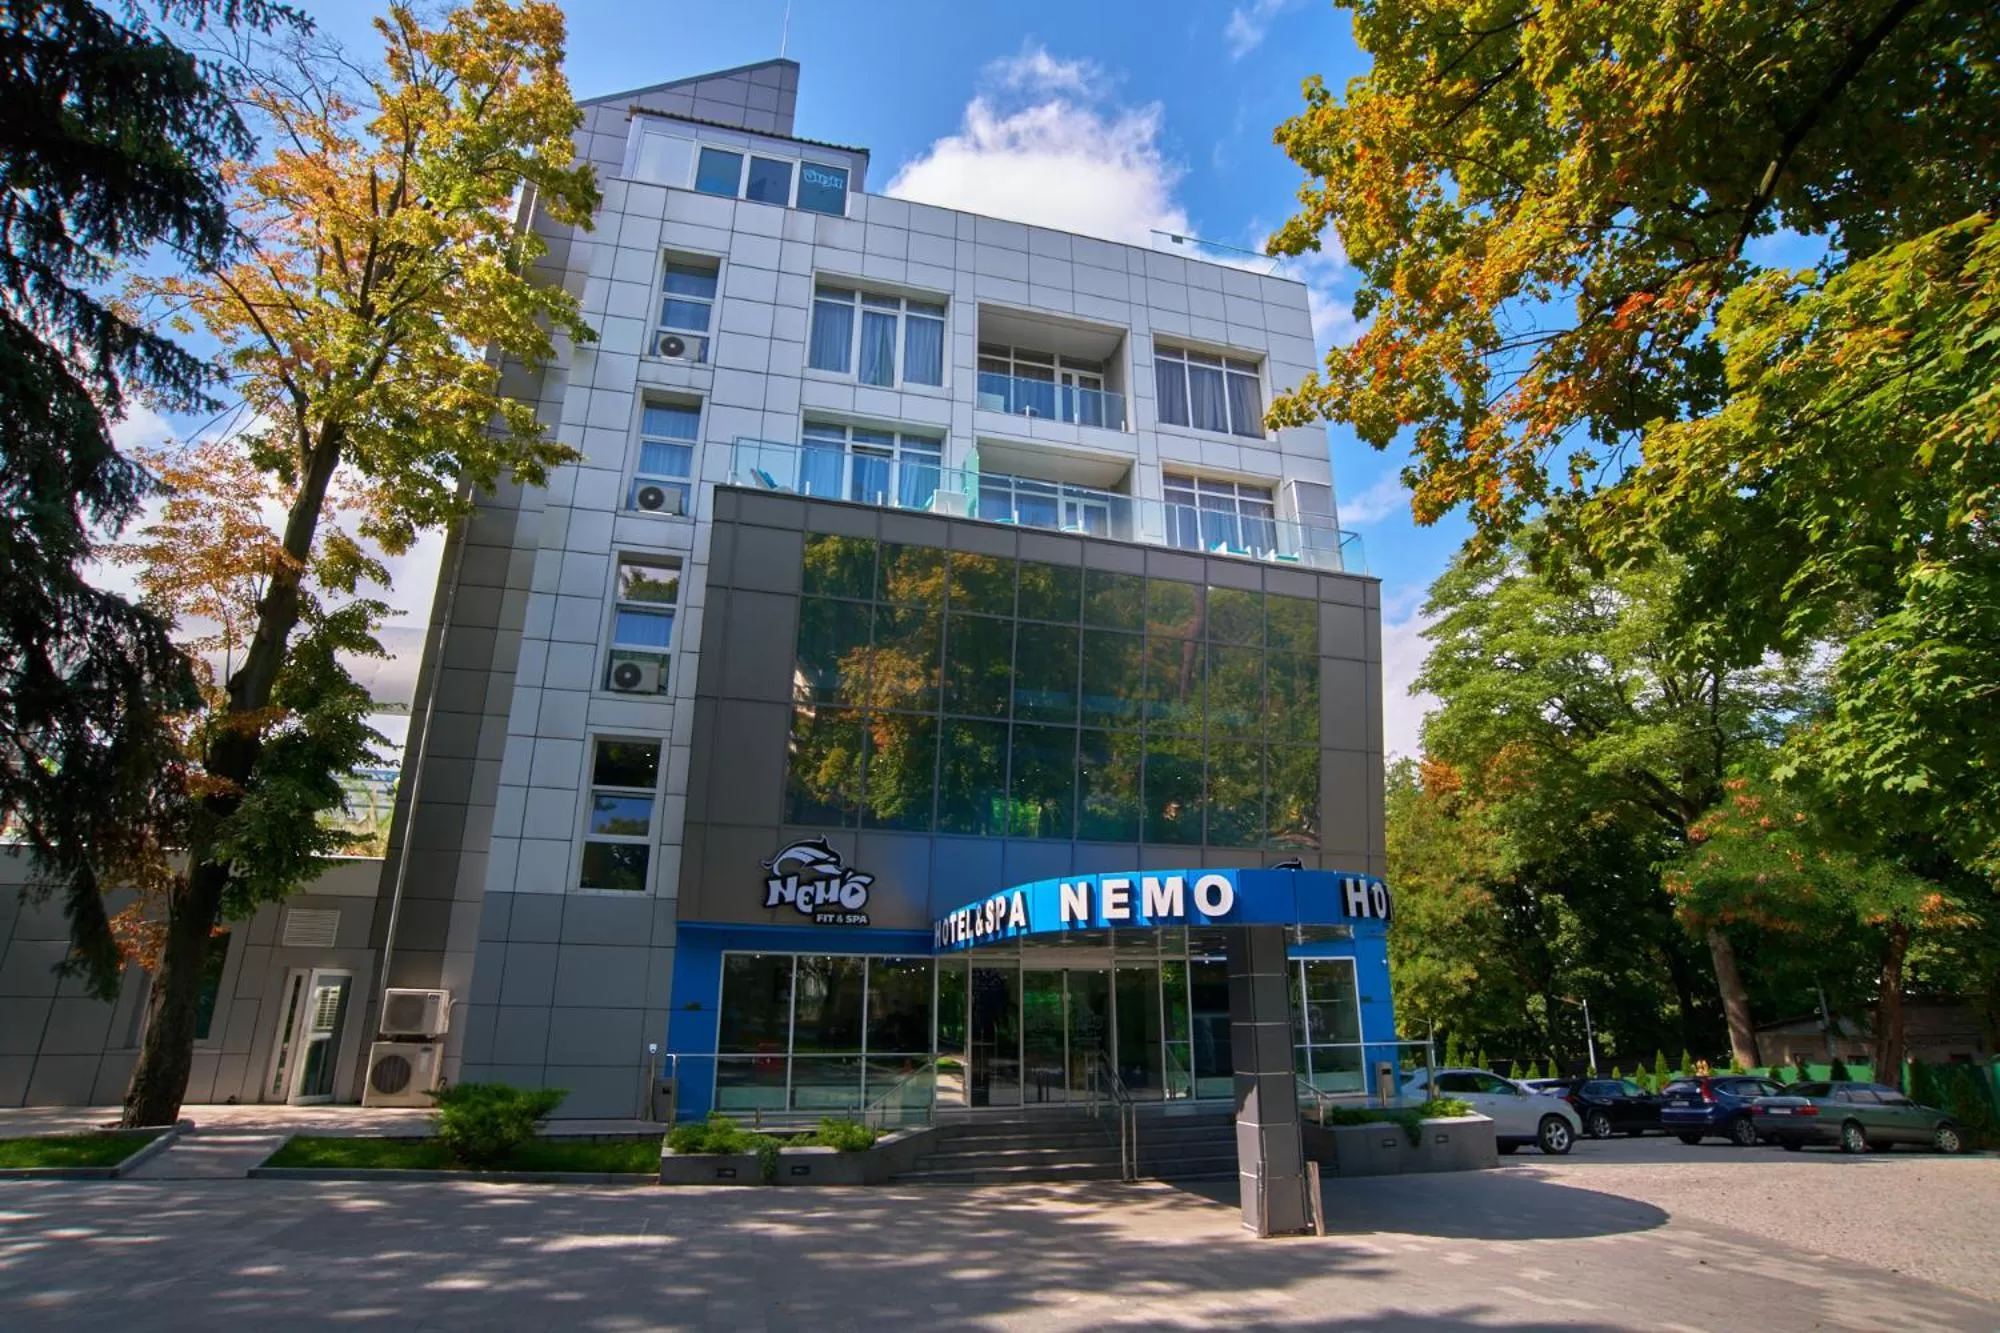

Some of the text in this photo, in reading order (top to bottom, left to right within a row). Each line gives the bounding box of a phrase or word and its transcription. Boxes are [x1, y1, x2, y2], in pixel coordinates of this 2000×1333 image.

[1059, 874, 1234, 922] NEMO
[816, 914, 868, 924] FIT & SPA
